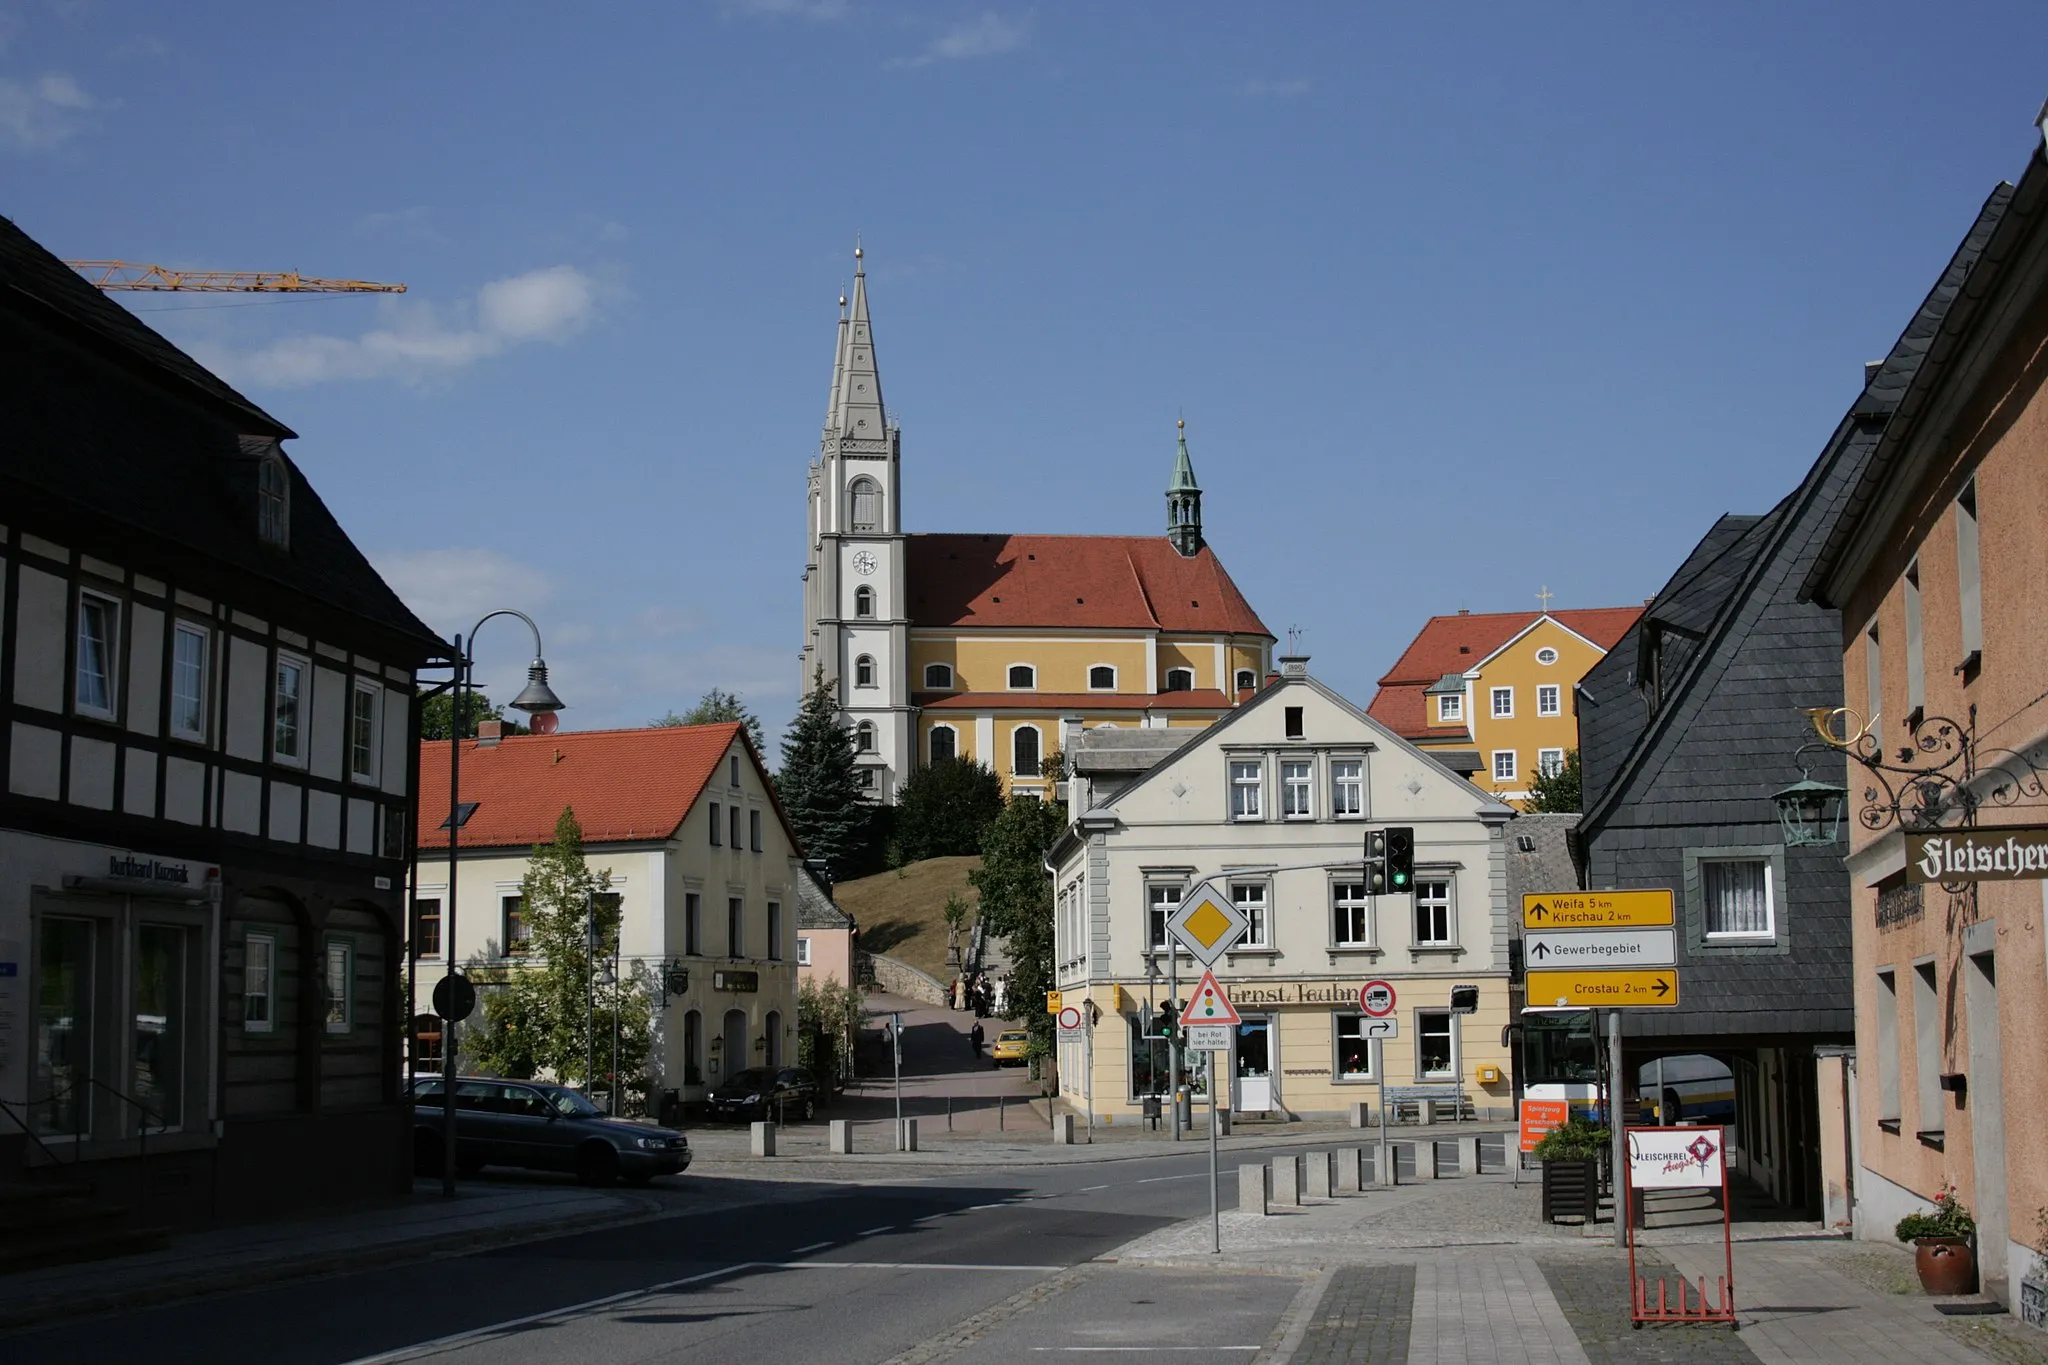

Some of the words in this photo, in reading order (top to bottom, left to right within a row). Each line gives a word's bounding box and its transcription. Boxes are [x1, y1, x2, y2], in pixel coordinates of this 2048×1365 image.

[1552, 898, 1584, 909] Weifa
[1589, 898, 1596, 908] 5
[1598, 900, 1612, 908] km
[1553, 912, 1603, 922] Kirschau
[1608, 911, 1615, 921] 2
[1617, 912, 1631, 921] km
[1554, 943, 1641, 956] Gewerbegebiet
[1574, 983, 1620, 994] Crostau
[1624, 983, 1631, 993] 2
[1528, 1105, 1561, 1114] Spielzeug
[1636, 1152, 1688, 1161] FLEISCHEREI
[1662, 1156, 1695, 1175] Augst
